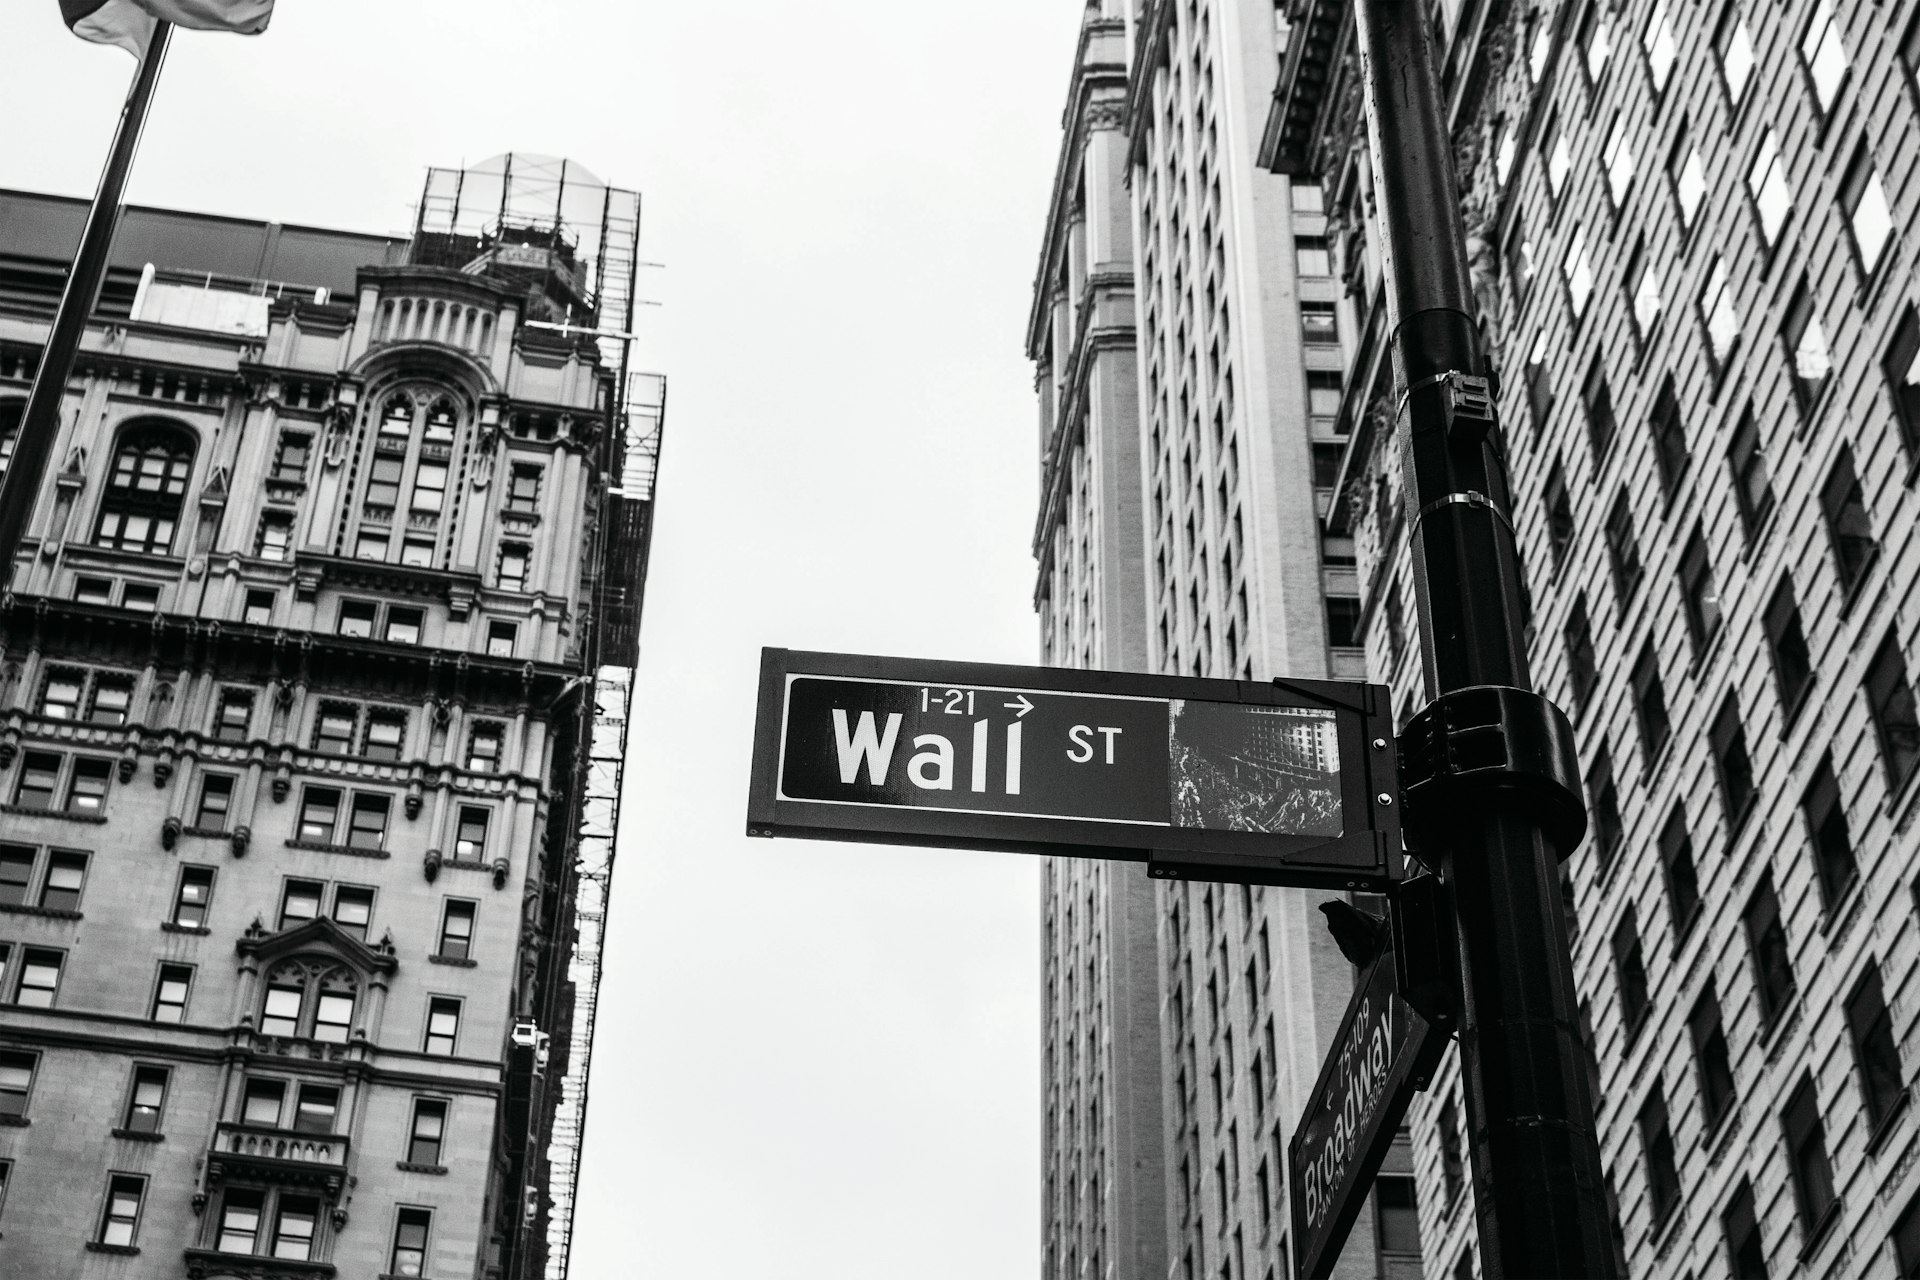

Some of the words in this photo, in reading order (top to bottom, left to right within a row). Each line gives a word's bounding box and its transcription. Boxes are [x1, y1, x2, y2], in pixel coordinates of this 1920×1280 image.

[921, 688, 975, 715] 1-21
[832, 708, 1022, 795] Wall
[1066, 725, 1123, 765] ST
[1338, 997, 1370, 1089] 75-109
[1304, 992, 1393, 1229] Broadway
[1317, 1159, 1345, 1229] CANYON
[1347, 1130, 1356, 1162] OF
[1360, 1064, 1387, 1135] HEROES
